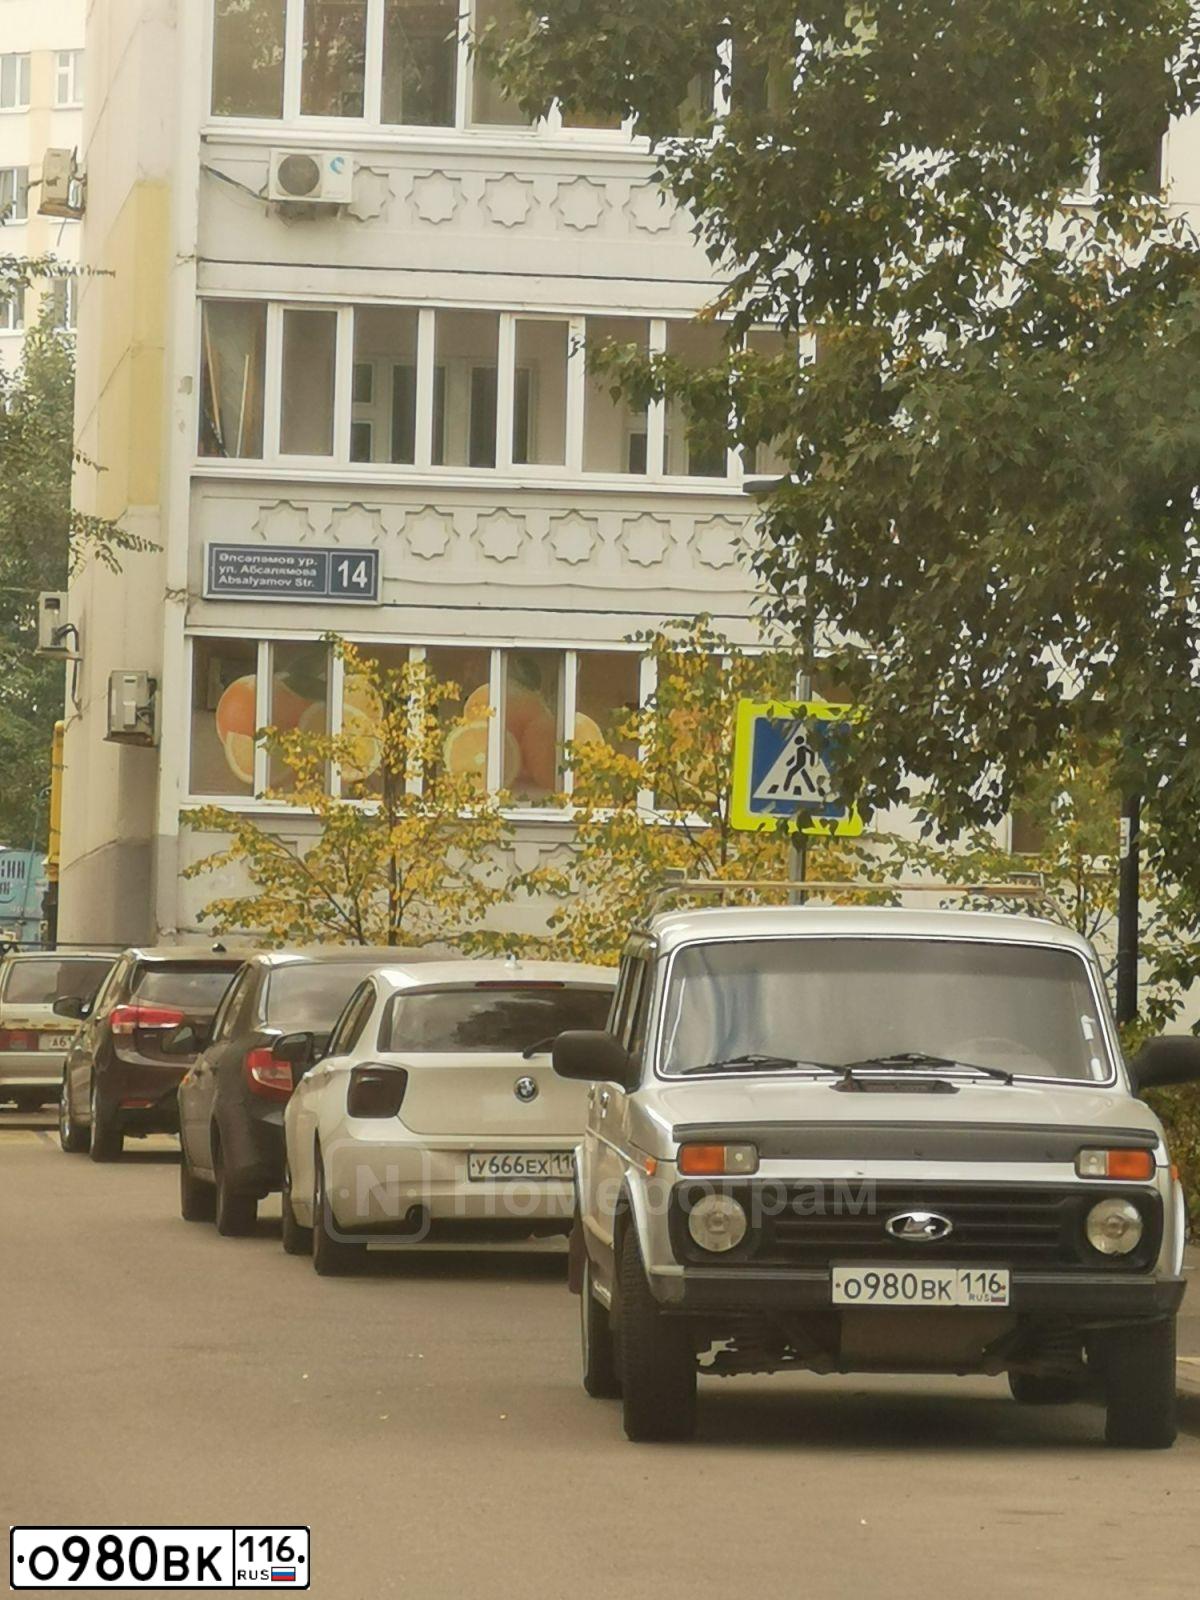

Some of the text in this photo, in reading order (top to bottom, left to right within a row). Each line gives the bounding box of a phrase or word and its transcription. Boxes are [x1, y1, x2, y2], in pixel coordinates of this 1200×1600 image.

[298, 557, 318, 568] ур.
[240, 565, 317, 577] Абсалямова
[338, 559, 368, 588] 14
[218, 575, 315, 588] Absalyamov Str.
[844, 1272, 1001, 1301] О980ВК 116
